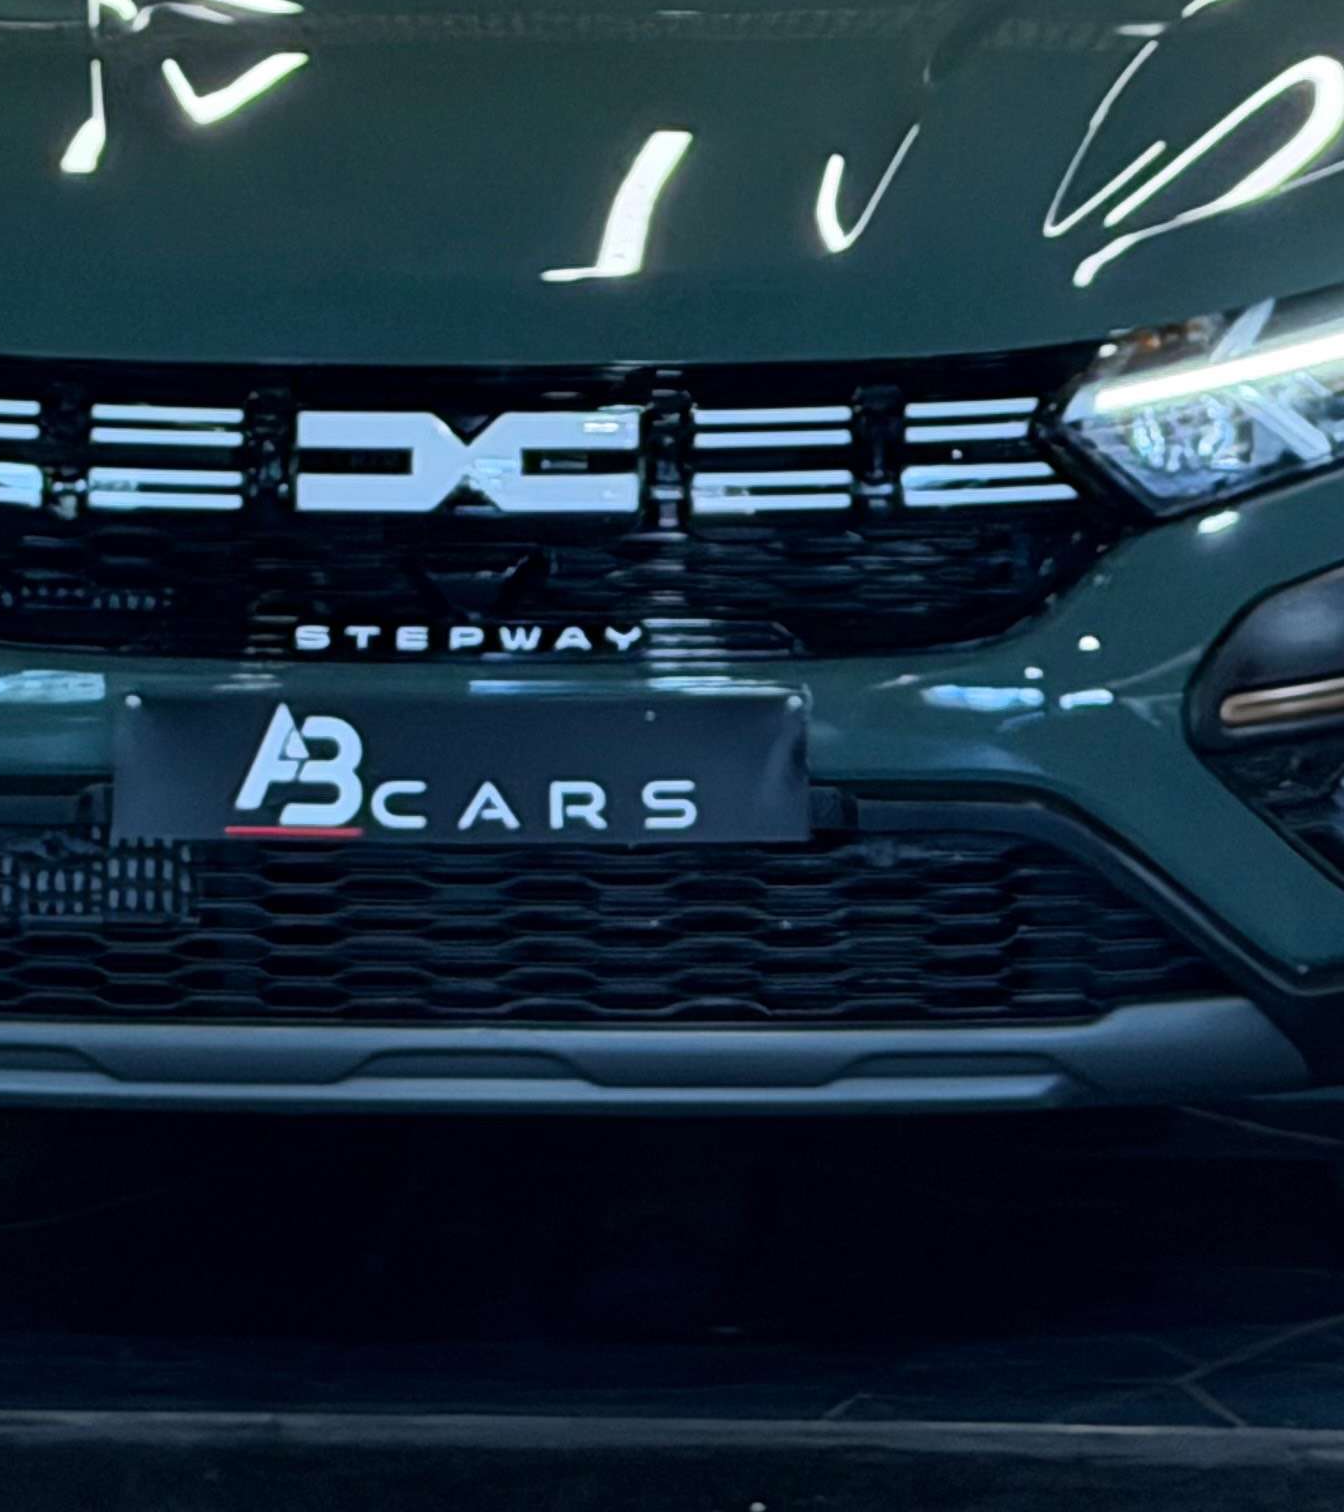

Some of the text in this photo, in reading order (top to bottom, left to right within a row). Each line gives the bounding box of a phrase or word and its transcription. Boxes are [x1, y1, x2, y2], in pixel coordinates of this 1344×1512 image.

[295, 625, 643, 651] STEPWAY
[235, 702, 698, 829] AB CARS
